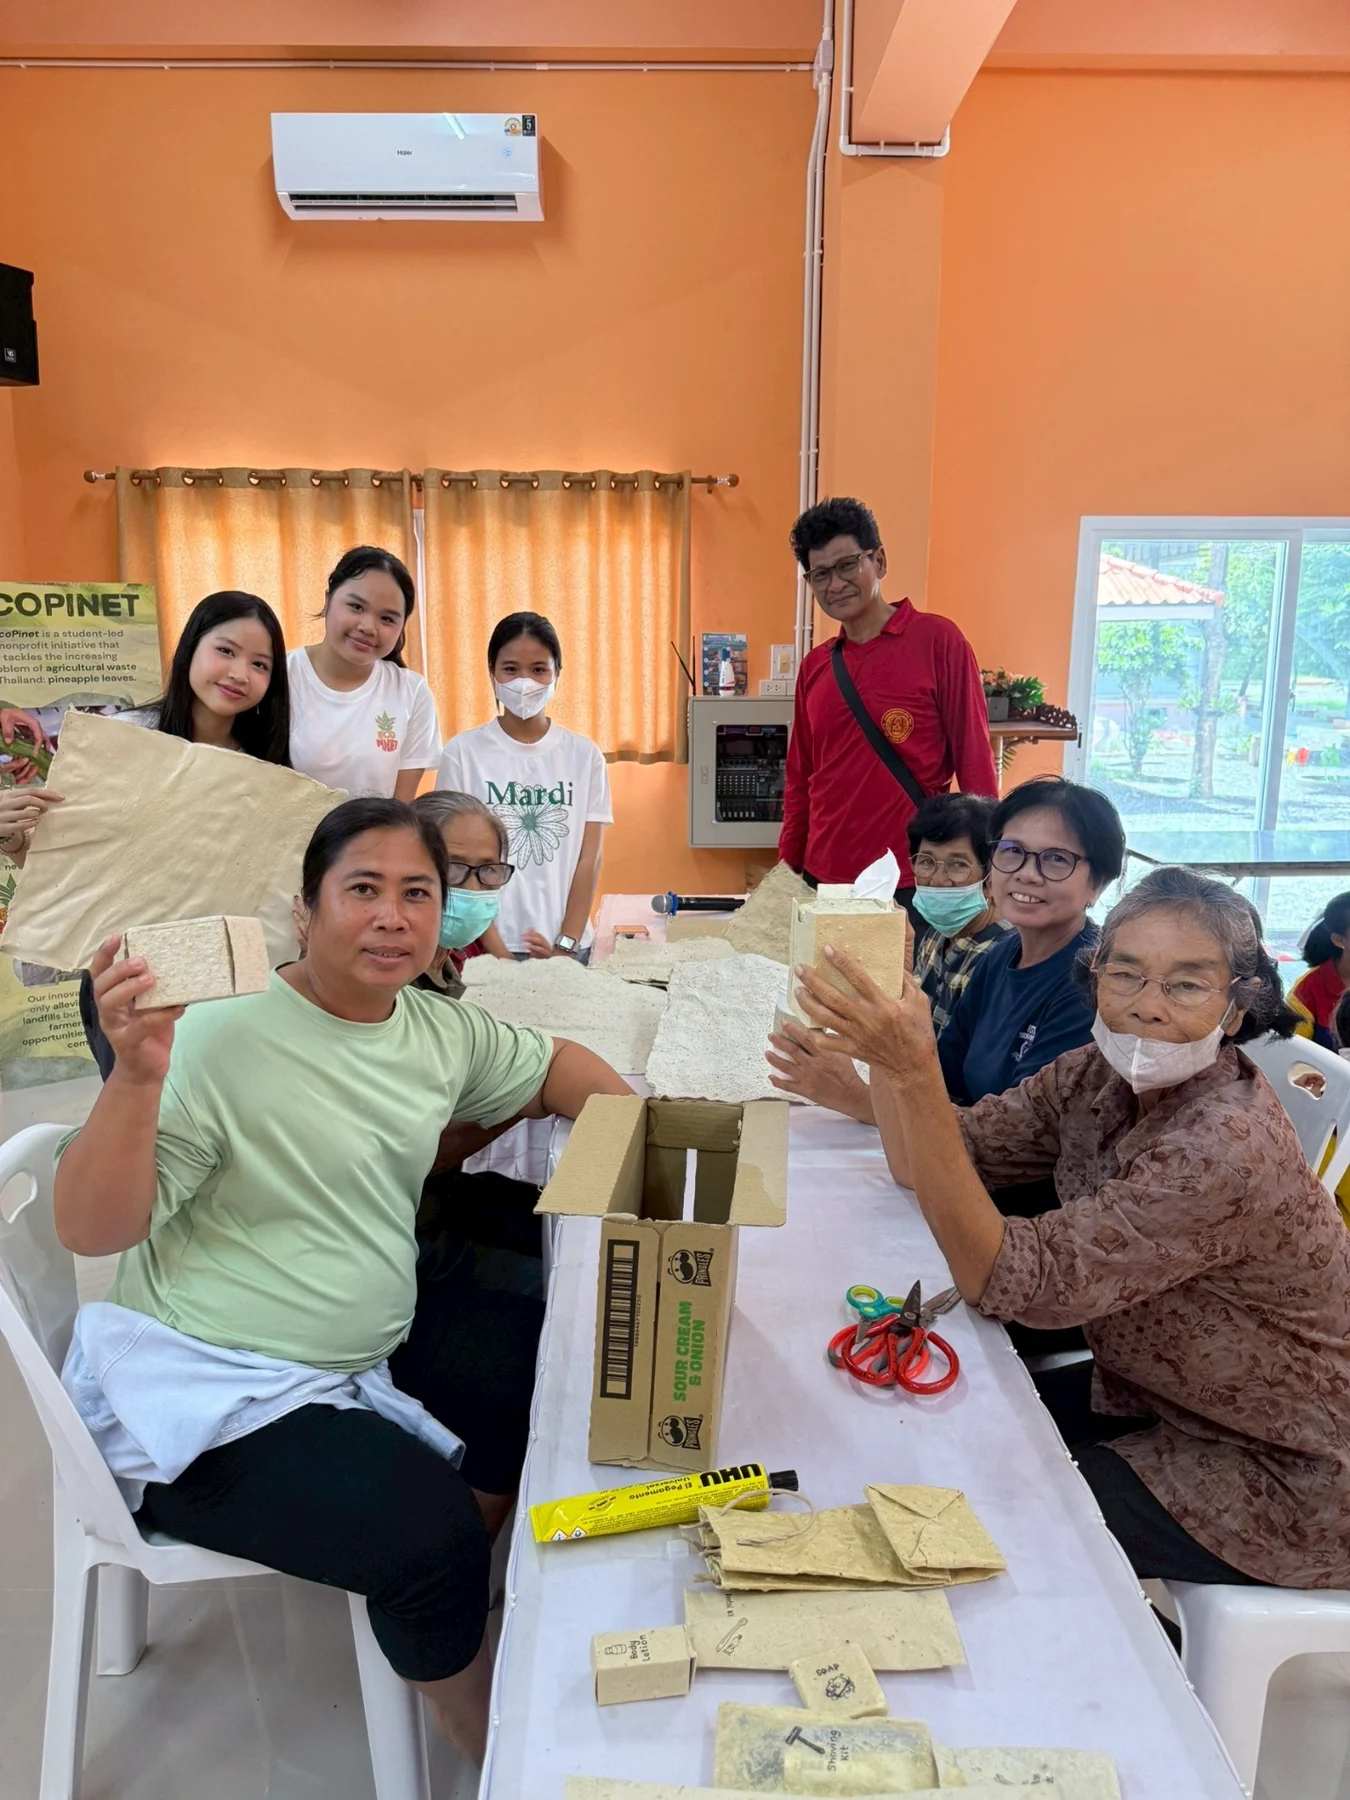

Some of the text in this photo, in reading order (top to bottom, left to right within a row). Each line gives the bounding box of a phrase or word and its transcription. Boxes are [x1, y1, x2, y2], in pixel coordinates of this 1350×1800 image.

[42, 630, 51, 638] is
[62, 629, 124, 638] student-led
[0, 641, 120, 651] nonprofit initiative that
[3, 651, 118, 662] tackles the increasing
[32, 664, 43, 673] of
[46, 663, 105, 674] agricultural
[106, 663, 137, 671] waste
[48, 674, 100, 686] pineapple
[101, 674, 137, 682] leaves.
[485, 781, 573, 807] Mardi
[27, 995, 46, 1003] Our
[30, 1004, 51, 1014] only
[22, 1011, 80, 1025] landfills but
[695, 1253, 711, 1285] PRINGLES
[673, 1301, 693, 1401] SOUR CREAM
[688, 1319, 706, 1386] & ONION
[700, 1463, 762, 1488] UHU
[646, 1476, 691, 1490] Universal
[684, 1481, 693, 1490] El
[629, 1485, 683, 1501] Pegamento
[628, 1640, 641, 1660] Body
[639, 1634, 651, 1662] Lotion
[815, 1663, 839, 1676] SOAP
